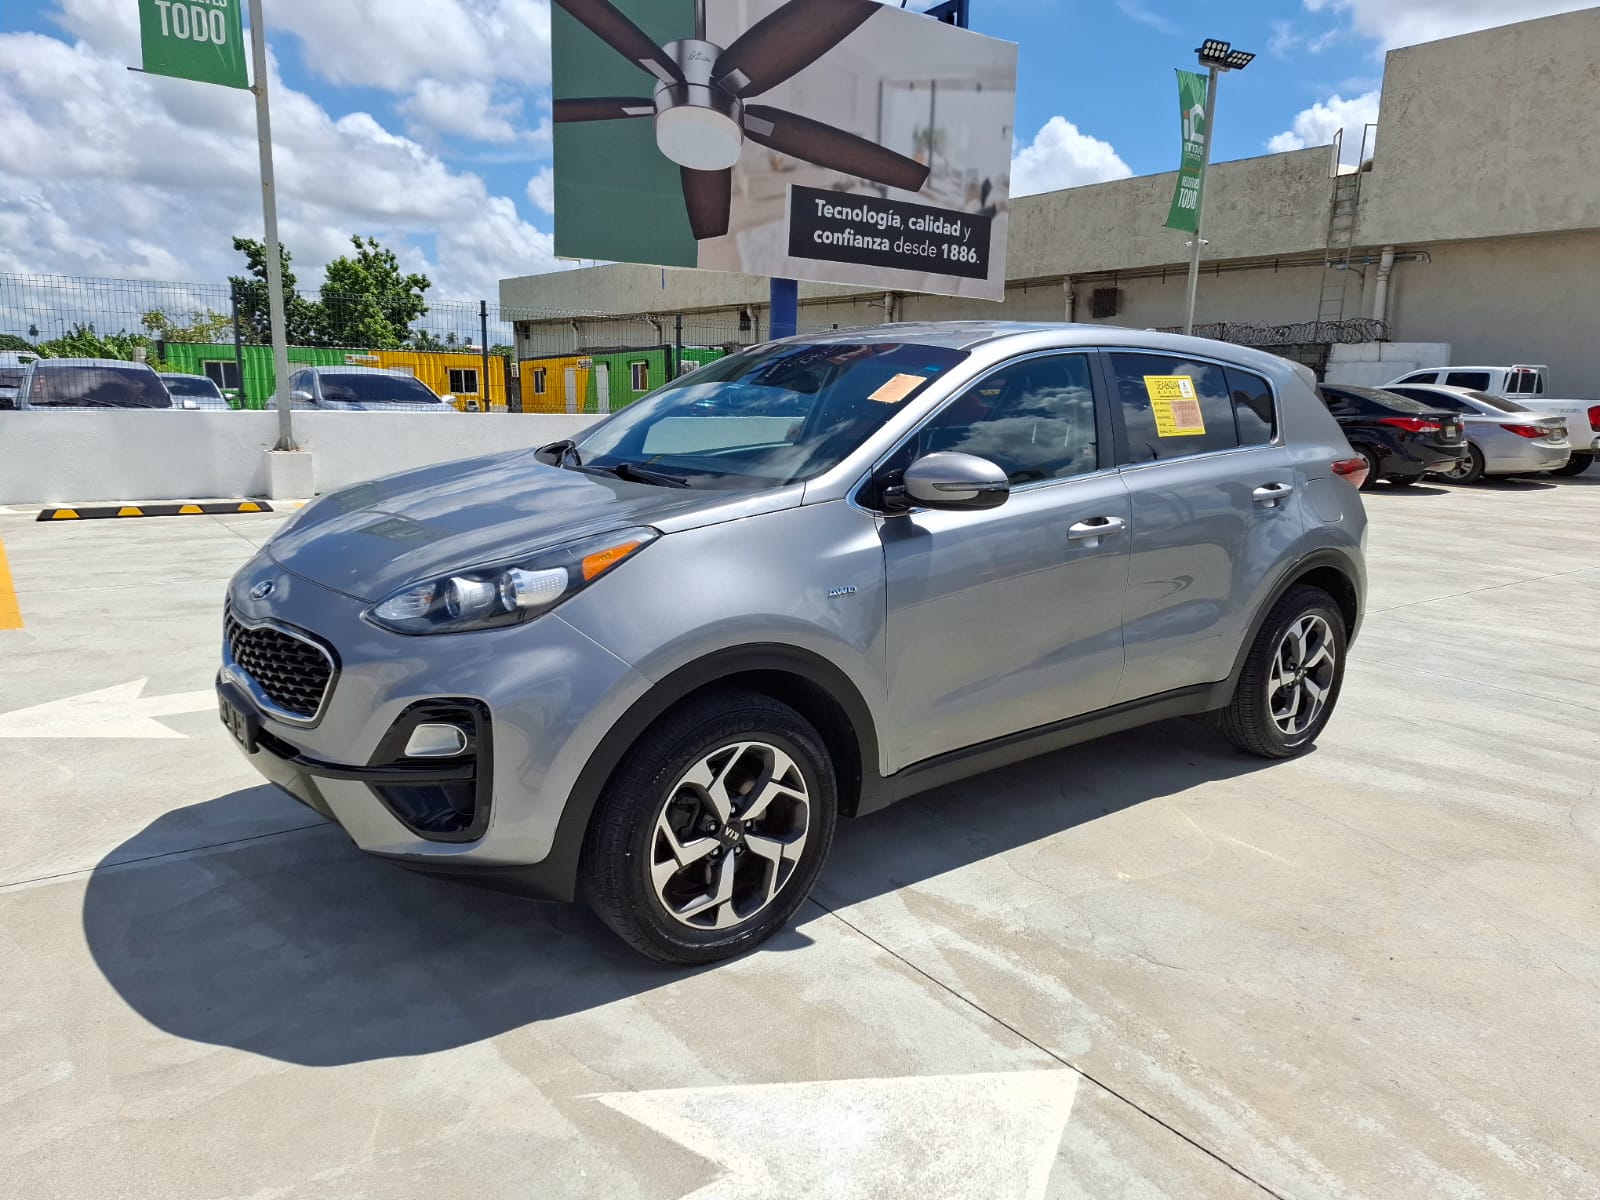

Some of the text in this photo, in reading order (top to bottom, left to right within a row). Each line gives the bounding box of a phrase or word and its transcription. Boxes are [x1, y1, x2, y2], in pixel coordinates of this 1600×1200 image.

[154, 1, 226, 45] TODO
[1178, 188, 1198, 209] TODO
[814, 198, 972, 242] Tecnología, calidad y
[813, 228, 980, 264] confianza desde 1886.
[724, 826, 740, 841] KIA
